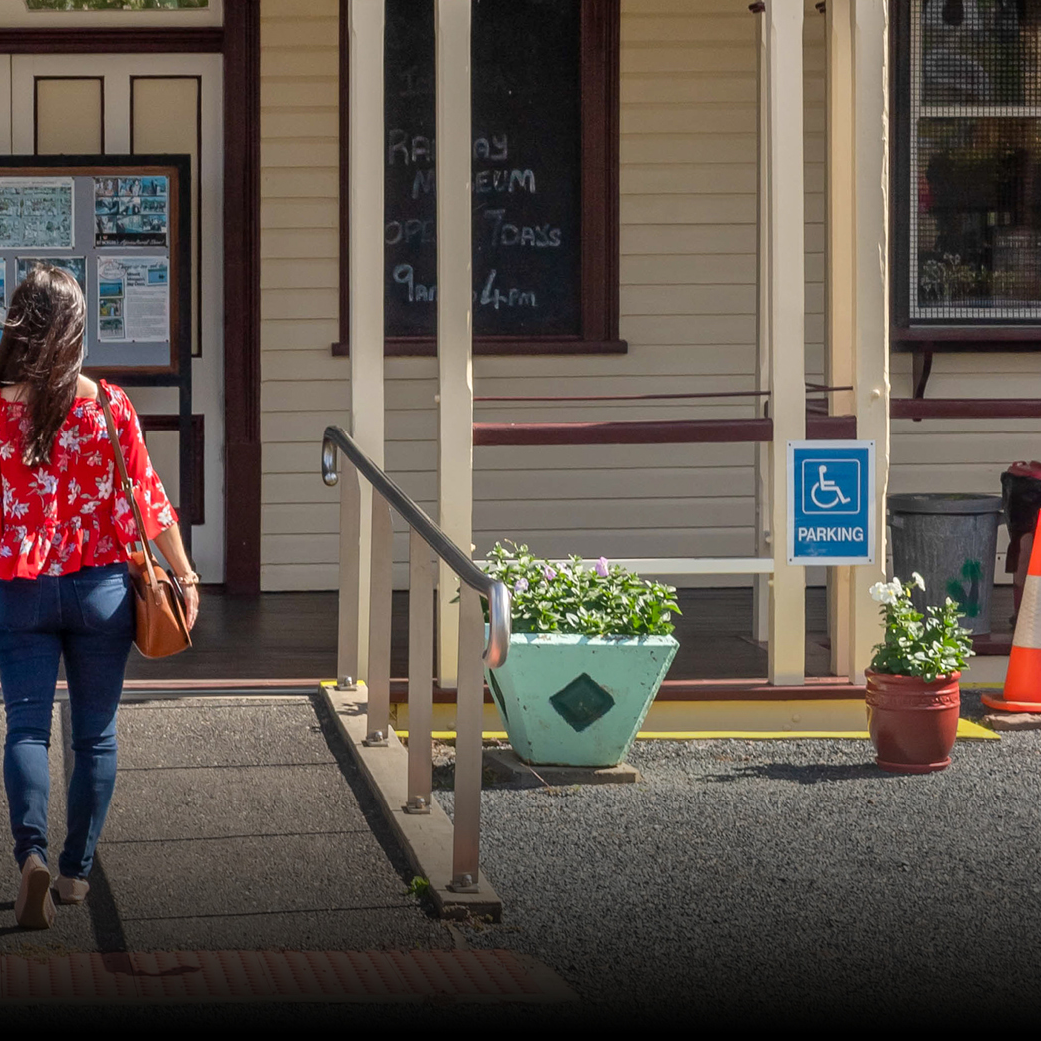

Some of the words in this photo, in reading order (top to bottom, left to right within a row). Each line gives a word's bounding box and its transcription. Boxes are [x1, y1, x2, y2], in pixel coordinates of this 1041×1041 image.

[388, 128, 508, 166] RAIAY
[411, 169, 536, 200] MEUM
[798, 526, 864, 542] PARKING
